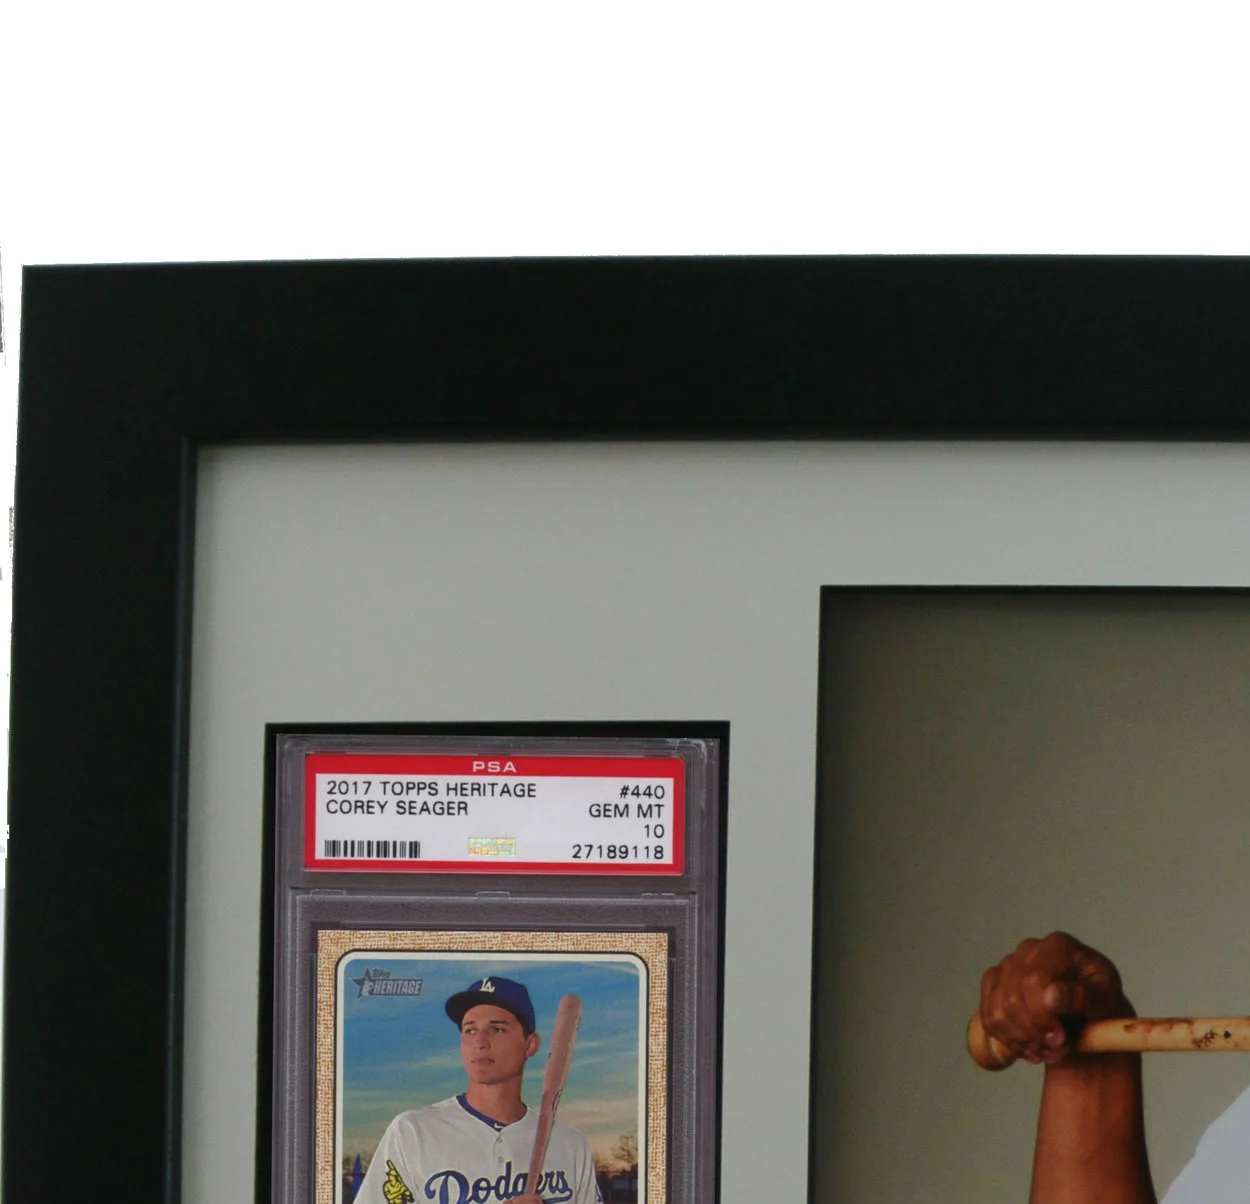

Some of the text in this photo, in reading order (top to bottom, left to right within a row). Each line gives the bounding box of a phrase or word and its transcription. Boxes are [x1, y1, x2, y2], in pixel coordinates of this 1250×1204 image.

[472, 760, 517, 774] PSA
[326, 780, 537, 800] 2017 TOPPS HERITAGE
[619, 784, 666, 802] #440
[326, 800, 469, 818] COREY SEAGER
[588, 803, 665, 820] GEM MT
[643, 823, 665, 839] 10
[571, 843, 665, 861] 27189118
[372, 980, 421, 995] HERITAGE
